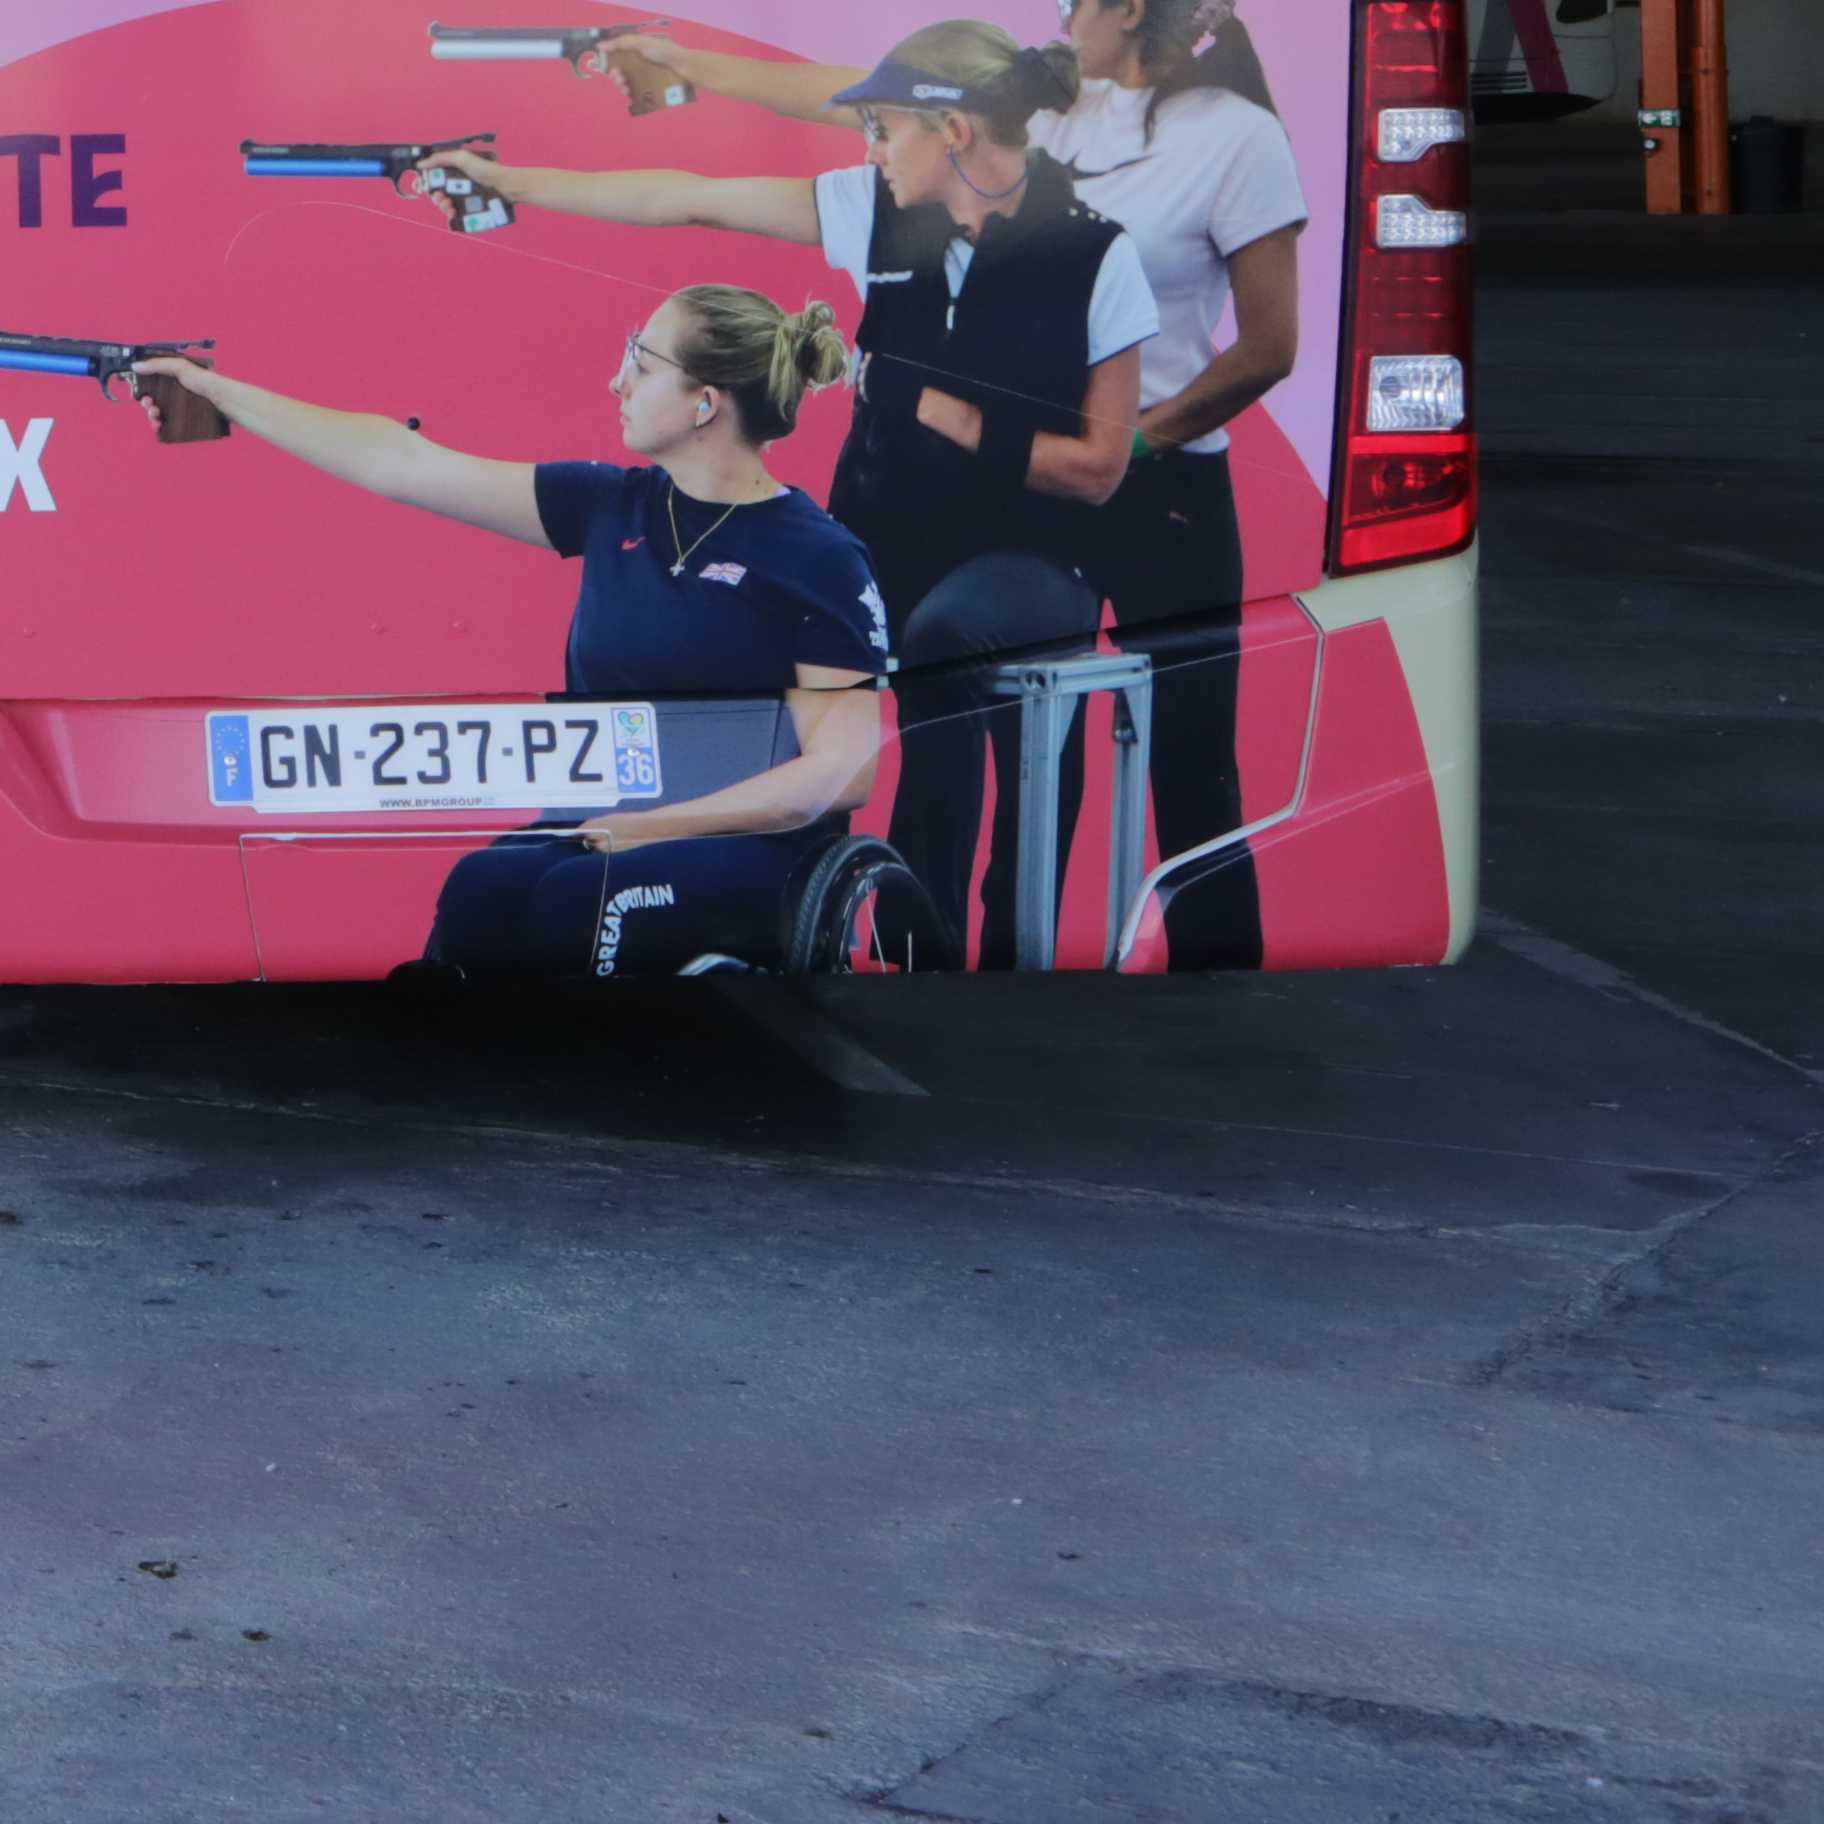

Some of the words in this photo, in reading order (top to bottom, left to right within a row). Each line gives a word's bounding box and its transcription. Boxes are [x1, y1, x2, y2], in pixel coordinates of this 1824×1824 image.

[260, 719, 604, 790] GN-237-PZ
[618, 753, 654, 785] 36
[596, 900, 622, 977] GREAT
[614, 884, 674, 913] BRITAIN
